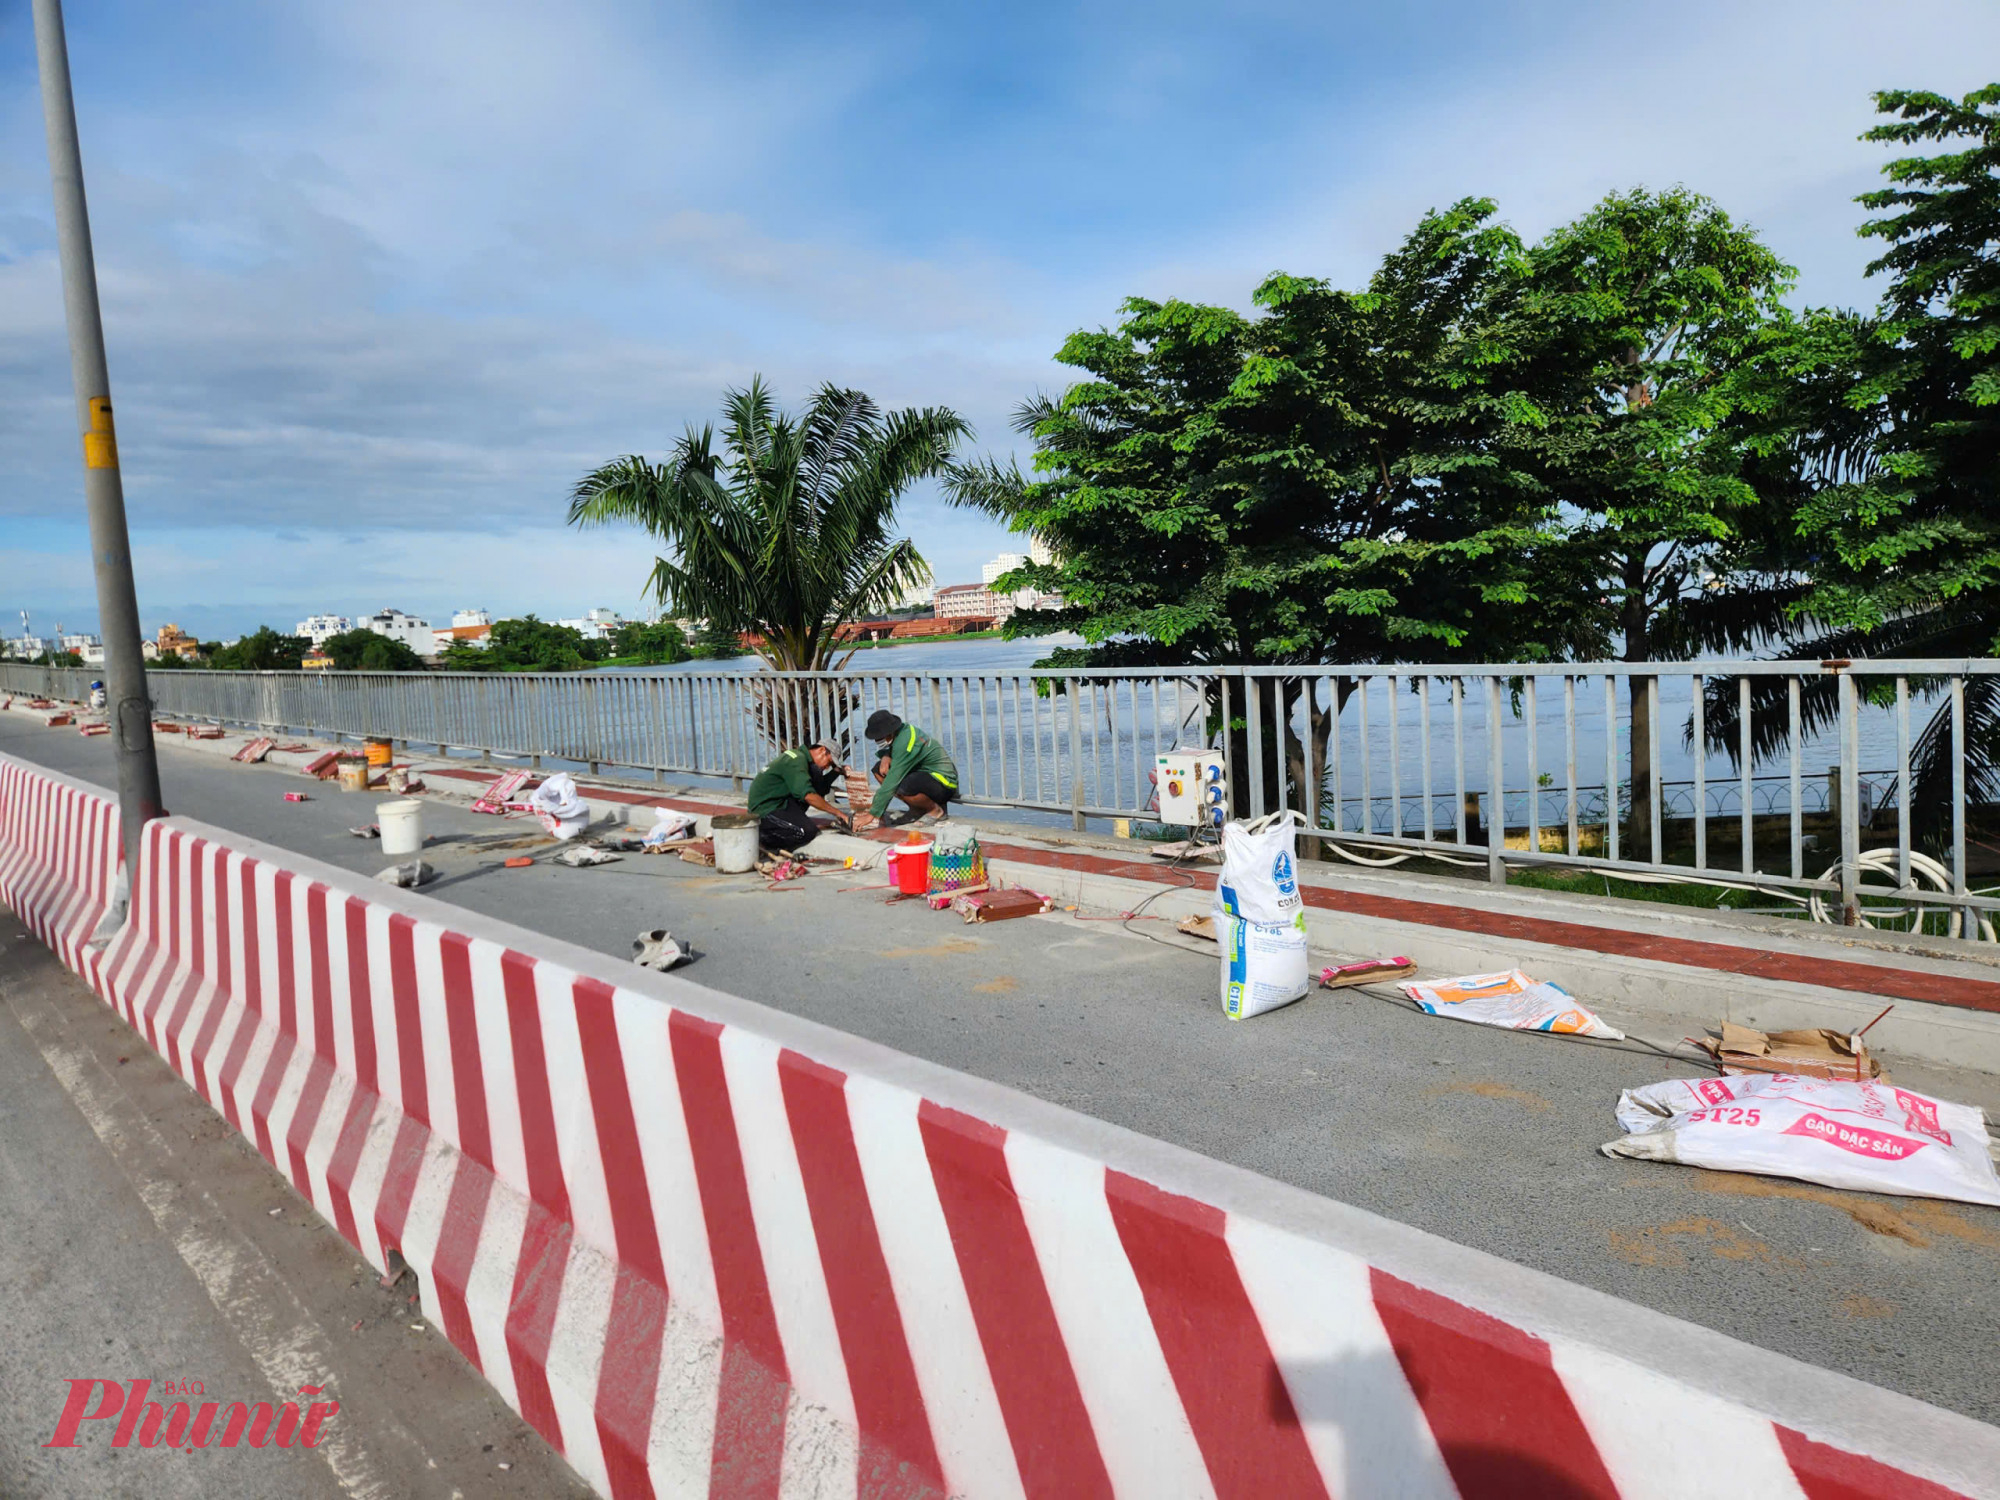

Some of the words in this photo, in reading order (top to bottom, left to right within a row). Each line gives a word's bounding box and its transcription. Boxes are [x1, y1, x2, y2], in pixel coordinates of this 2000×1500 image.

[1688, 1107, 1761, 1127] ST25
[1805, 1118, 1836, 1135] GẠO
[1871, 1138, 1904, 1156] SẢN
